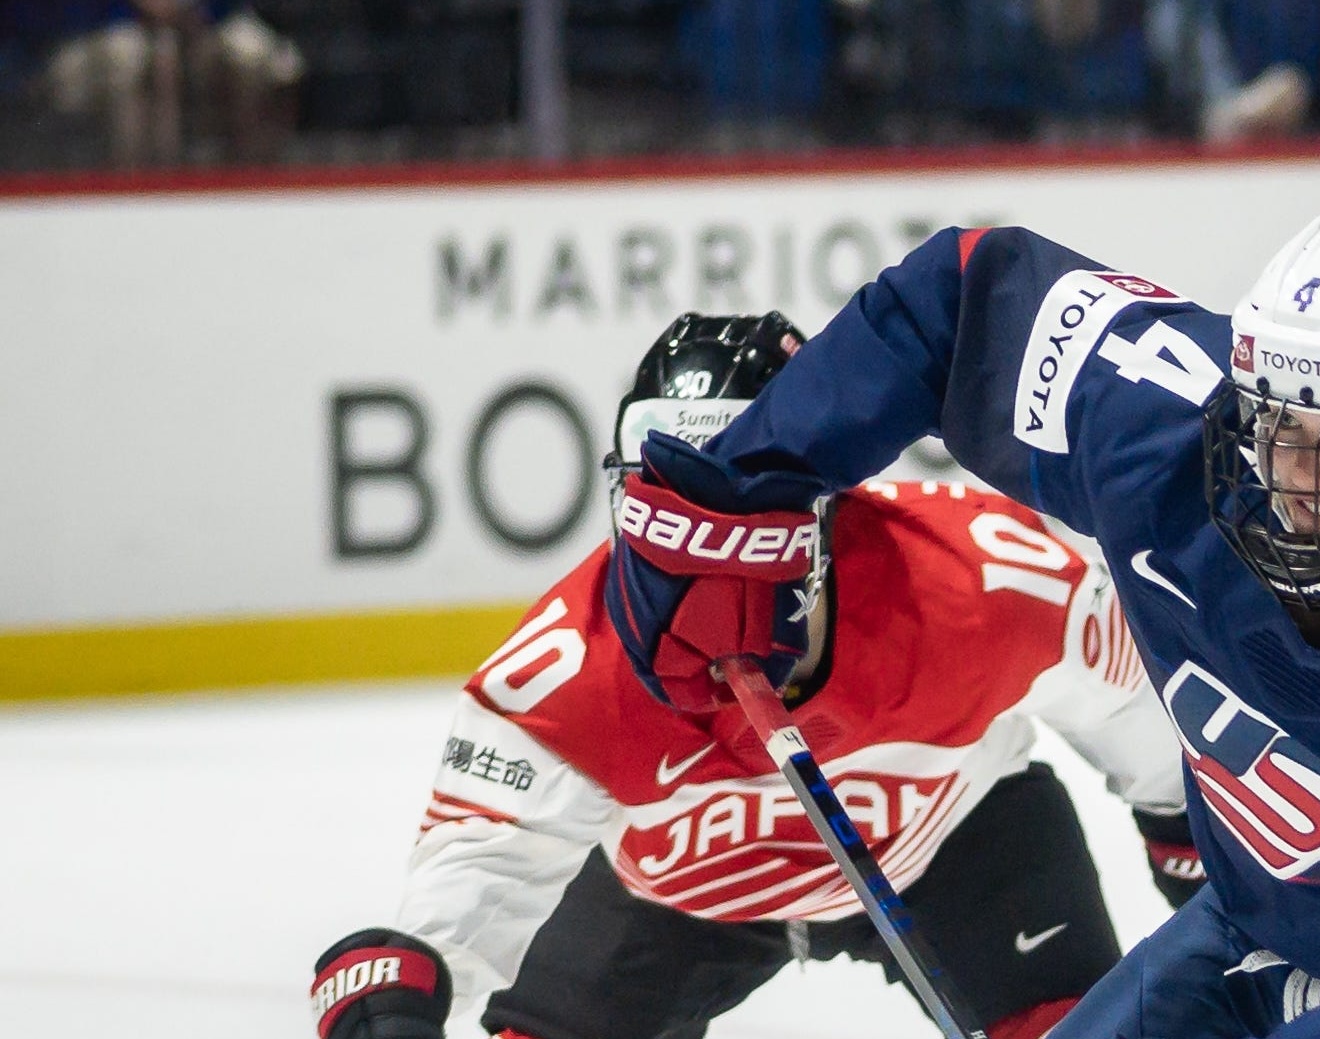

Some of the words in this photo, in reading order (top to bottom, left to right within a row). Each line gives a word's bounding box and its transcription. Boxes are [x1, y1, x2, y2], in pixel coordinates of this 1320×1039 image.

[433, 212, 1008, 322] MARRIO
[1026, 289, 1107, 432] TOYOTA
[1097, 320, 1224, 407] 4
[676, 410, 732, 426] Sumit
[968, 512, 1073, 607] 10
[477, 596, 587, 714] 10
